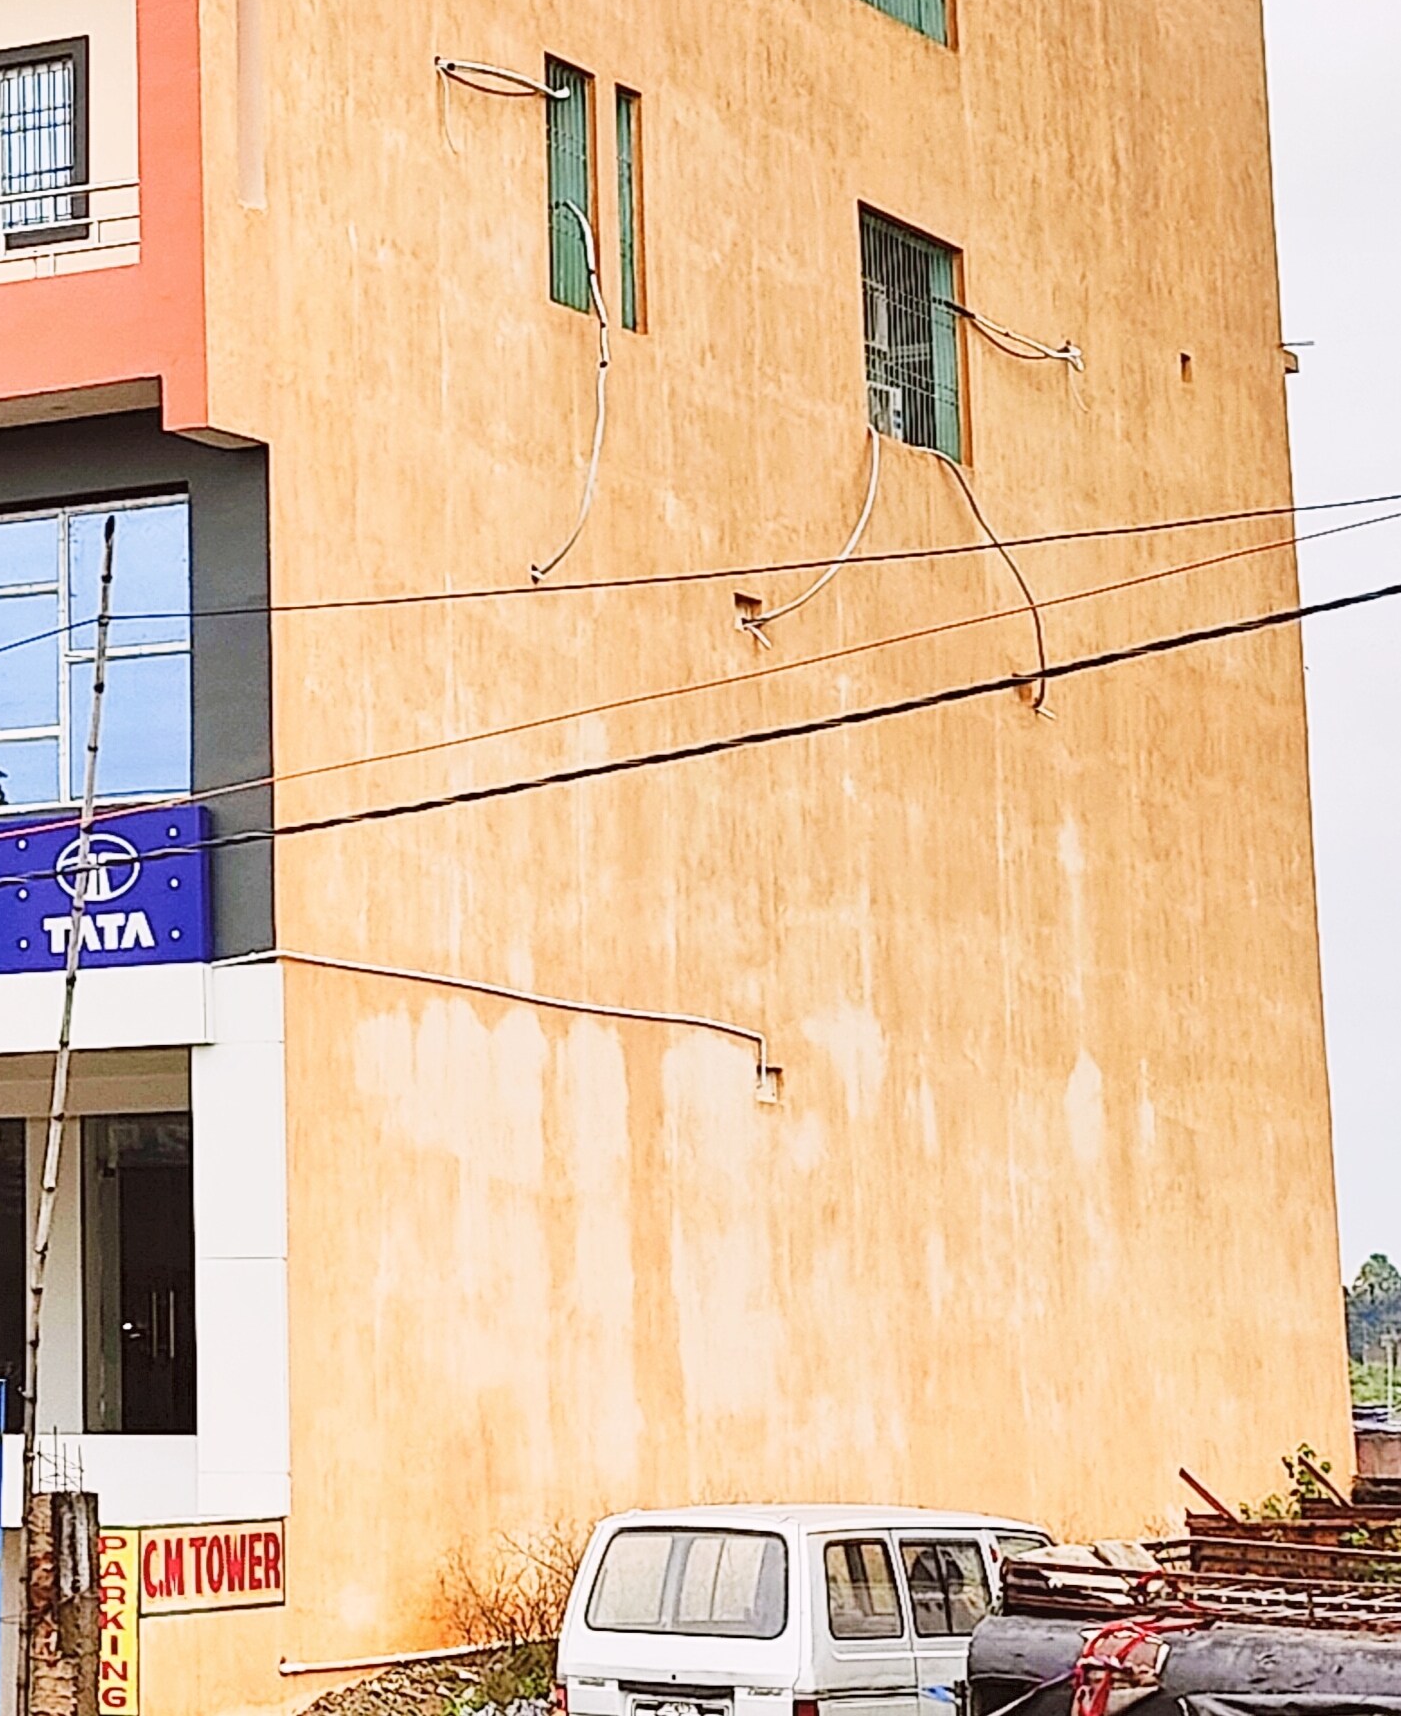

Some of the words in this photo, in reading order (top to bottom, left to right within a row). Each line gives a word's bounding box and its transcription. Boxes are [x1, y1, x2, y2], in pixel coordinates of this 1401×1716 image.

[43, 911, 156, 954] TATA
[143, 1538, 185, 1599] C.M
[189, 1532, 281, 1594] TOWER
[99, 1536, 128, 1708] PARKING
